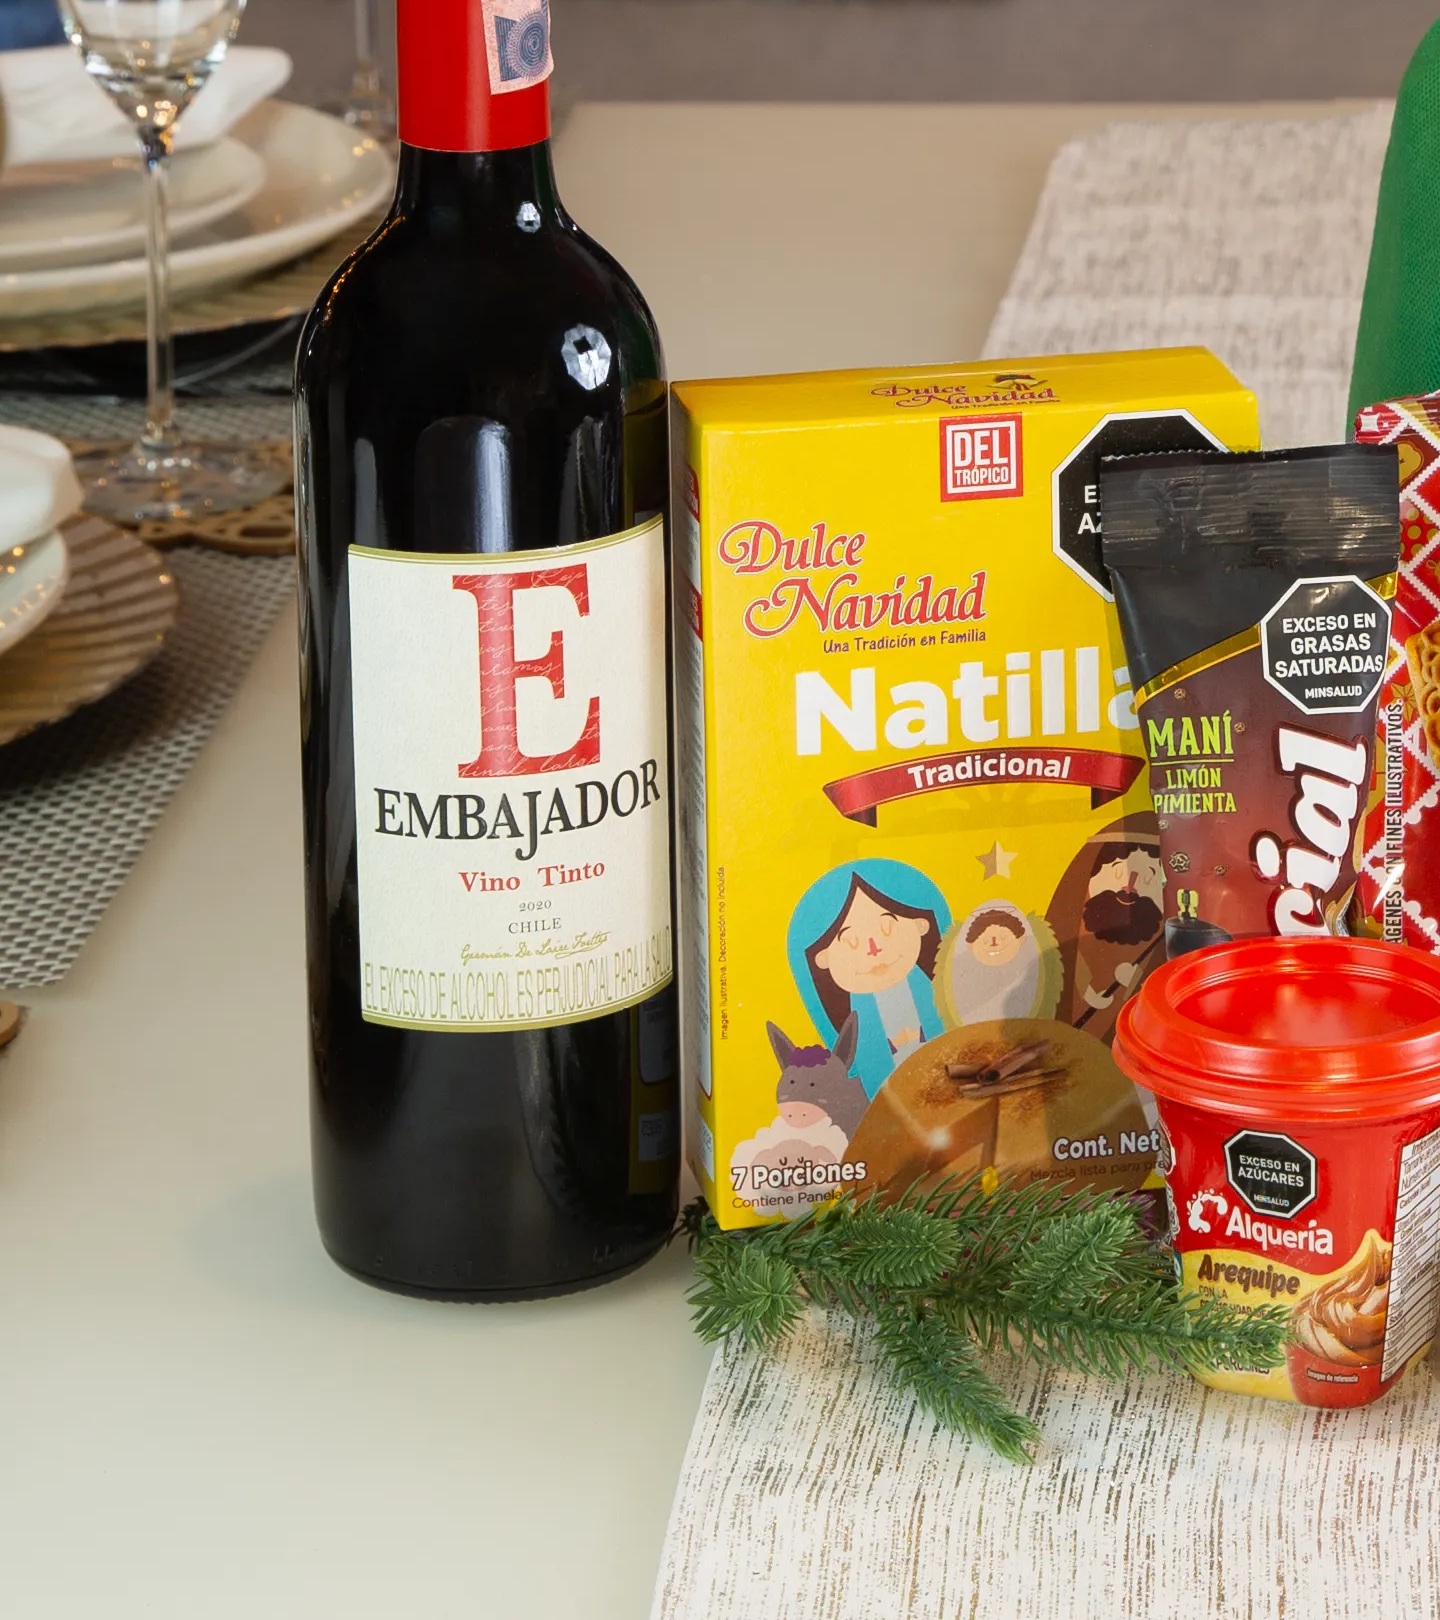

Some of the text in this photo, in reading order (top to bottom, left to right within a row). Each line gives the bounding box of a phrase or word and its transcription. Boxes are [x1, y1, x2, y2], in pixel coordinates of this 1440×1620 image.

[869, 383, 967, 397] Dulce
[895, 387, 1058, 408] Navidad
[954, 430, 1009, 467] DEL
[954, 465, 1009, 486] TRÓPICO
[718, 520, 868, 575] Dulce
[743, 571, 988, 639] Navidad
[1282, 613, 1376, 634] EXCESO EN
[822, 628, 987, 654] Una Tradición en Familia
[1290, 633, 1371, 655] GRASAS
[452, 563, 600, 778] E
[1275, 655, 1383, 678] SATURADAS
[1304, 685, 1363, 699] MINSALUD
[1147, 709, 1234, 757] MANÍ
[1386, 699, 1402, 804] ILUSTRATIVOS.
[907, 756, 1071, 790] Tradicional
[1165, 764, 1221, 789] LIMÓN
[374, 758, 661, 861] EMBAJADOR
[1154, 792, 1237, 814] PIMIENTA
[1255, 728, 1366, 936] cial
[1386, 809, 1402, 850] FINES
[459, 862, 606, 892] Vino Tinto
[519, 900, 552, 912] 2020
[508, 917, 562, 934] CHILE
[364, 963, 378, 1011] EL
[380, 965, 426, 1018] EXCESO
[429, 972, 446, 1019] DE
[449, 971, 515, 1021] ALCOHOL
[517, 970, 534, 1018] ES
[536, 955, 613, 1015] PERJUDICIAL
[614, 945, 639, 997] PARA
[1053, 1134, 1113, 1160] Cont.
[731, 1160, 868, 1192] 7 Porciones
[1080, 1163, 1106, 1176] lista
[1238, 1166, 1304, 1187] AZÚCARES
[1239, 1154, 1300, 1173] EXCESO EN
[732, 1188, 843, 1209] Contiene Panela
[1225, 1206, 1334, 1255] Alquería
[1197, 1254, 1301, 1298] Arequipe
